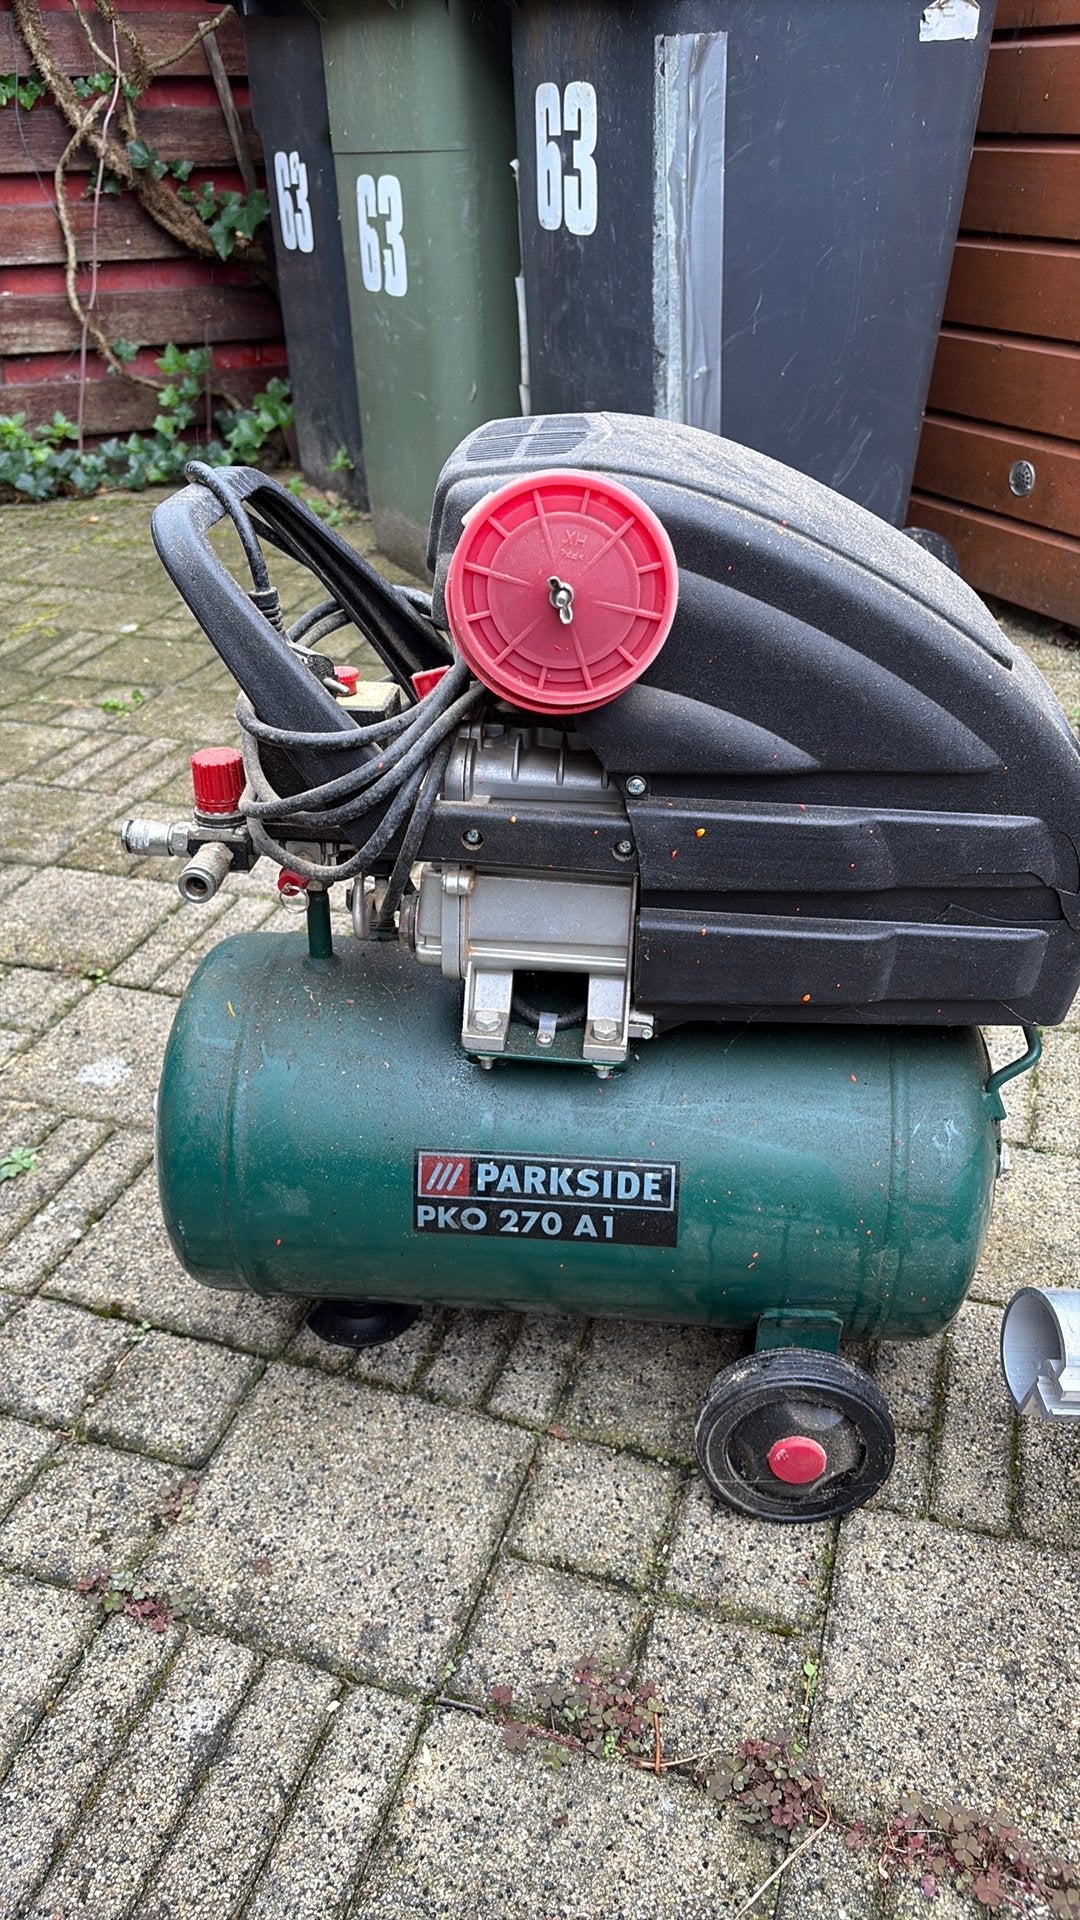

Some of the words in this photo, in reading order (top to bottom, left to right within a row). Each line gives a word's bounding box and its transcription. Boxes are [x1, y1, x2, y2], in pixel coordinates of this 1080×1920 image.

[274, 151, 314, 254] 63
[535, 81, 599, 236] 63
[356, 174, 408, 297] 63
[417, 1205, 487, 1231] PKO
[499, 1209, 562, 1235] 270
[573, 1214, 614, 1238] A1
[477, 1163, 662, 1202] PARKSIDE
